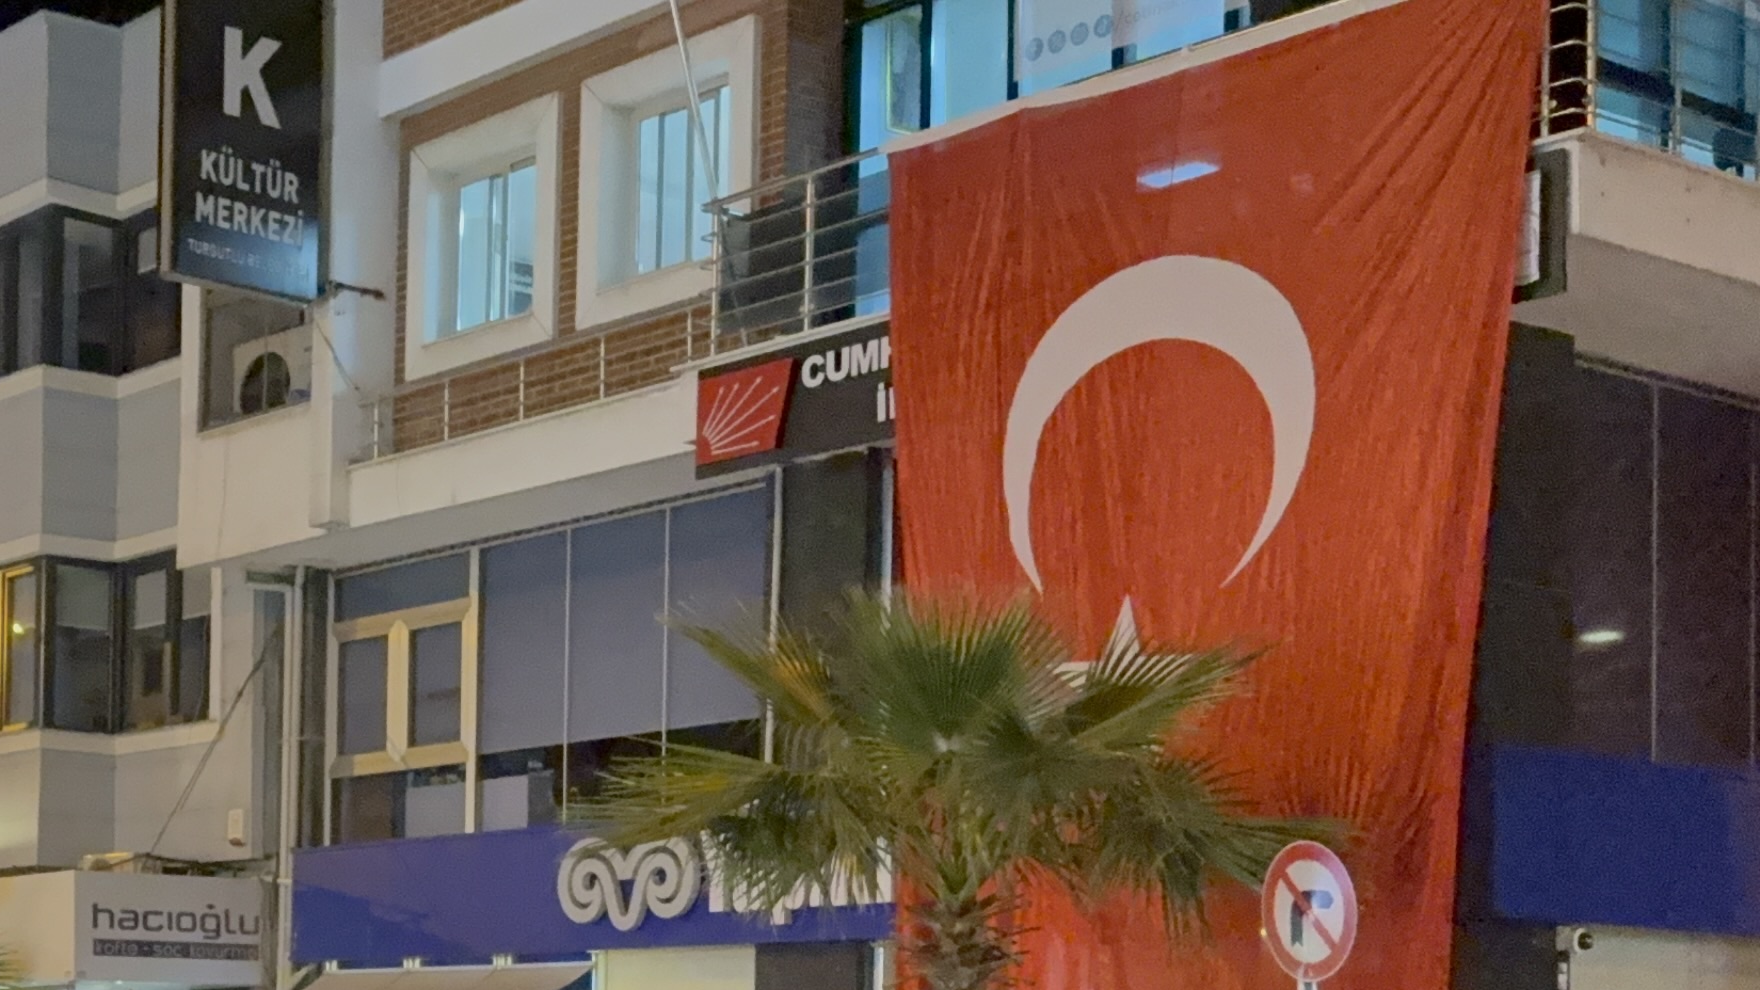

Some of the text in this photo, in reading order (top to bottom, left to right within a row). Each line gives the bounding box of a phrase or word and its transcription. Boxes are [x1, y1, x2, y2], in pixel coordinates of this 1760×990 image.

[222, 25, 283, 130] K
[200, 144, 300, 204] KÜLTÜR
[194, 191, 305, 248] MERKEZİ
